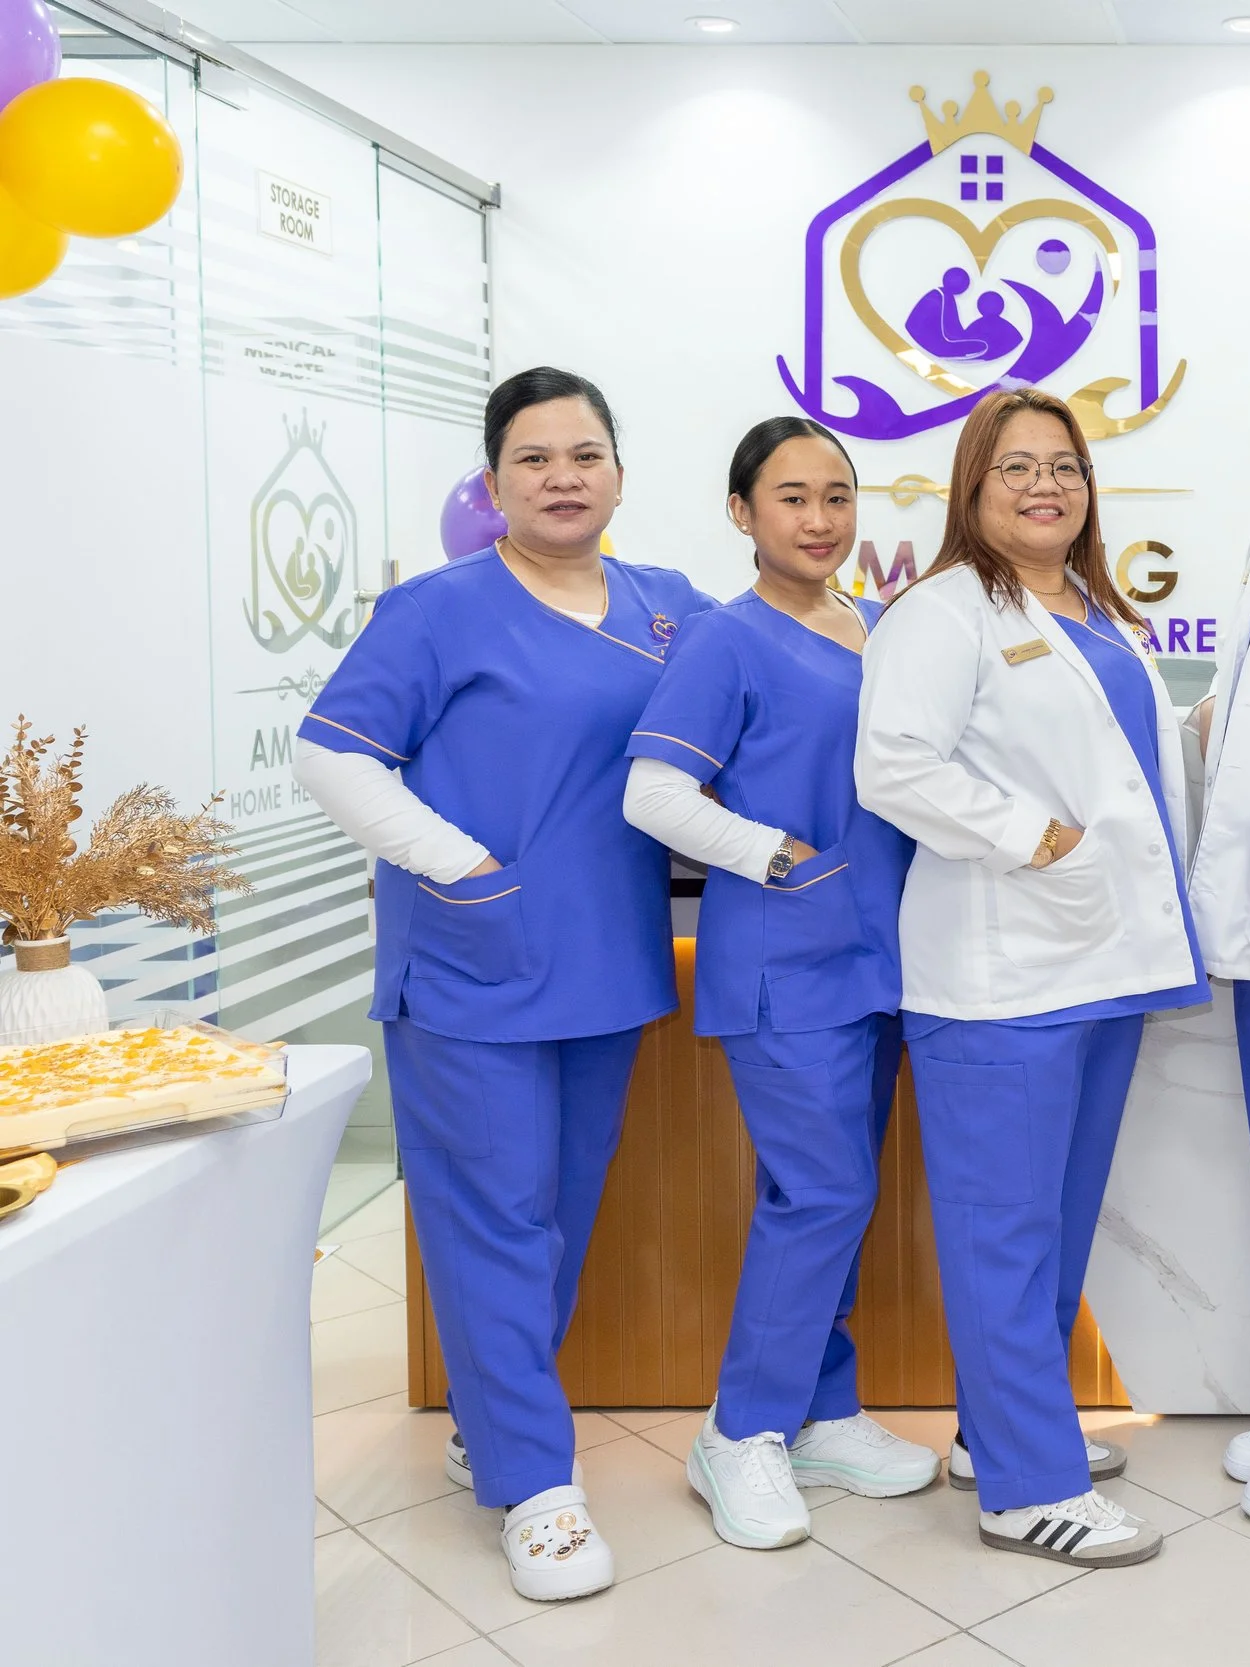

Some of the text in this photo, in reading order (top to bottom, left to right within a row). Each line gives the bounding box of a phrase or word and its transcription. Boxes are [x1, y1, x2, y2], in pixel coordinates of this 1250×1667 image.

[270, 183, 320, 220] STORAGE
[280, 212, 314, 242] ROOM
[230, 783, 282, 819] HOME
